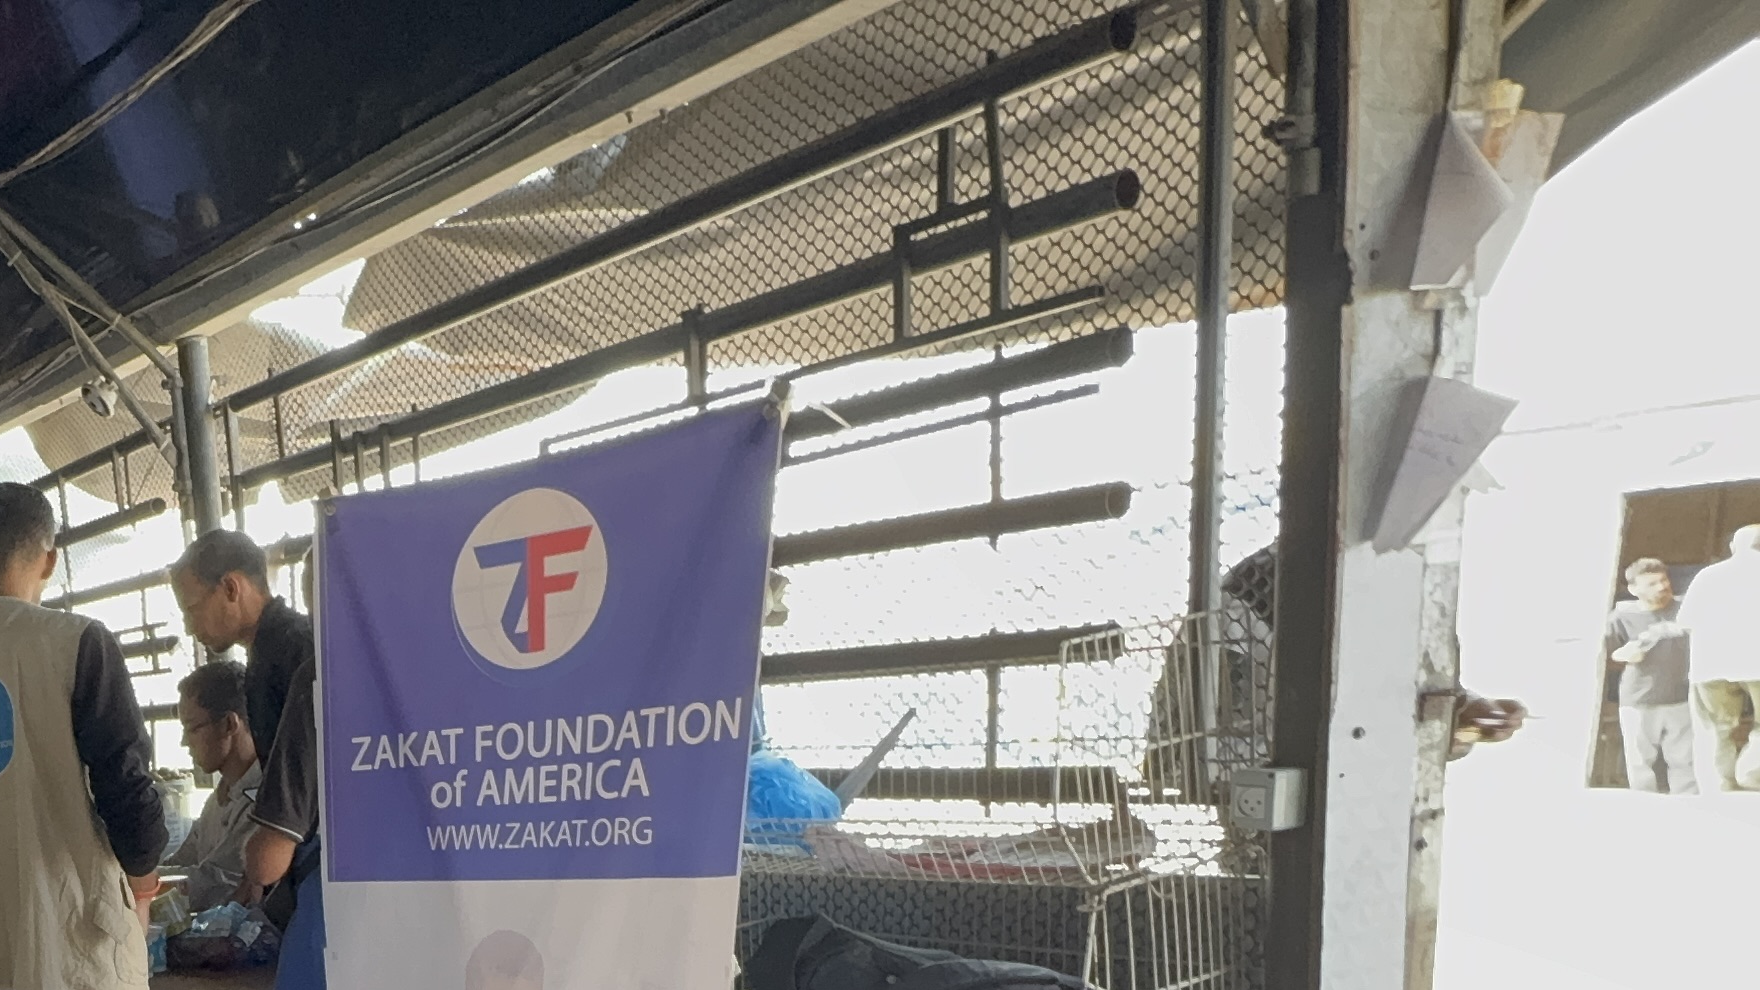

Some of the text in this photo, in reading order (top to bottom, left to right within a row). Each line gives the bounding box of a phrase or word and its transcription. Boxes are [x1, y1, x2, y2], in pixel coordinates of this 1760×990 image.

[350, 697, 742, 772] ZAKAT FOUNDATION
[430, 757, 650, 809] of AMERICA
[426, 816, 654, 851] WWW.ZAKAT.ORG
